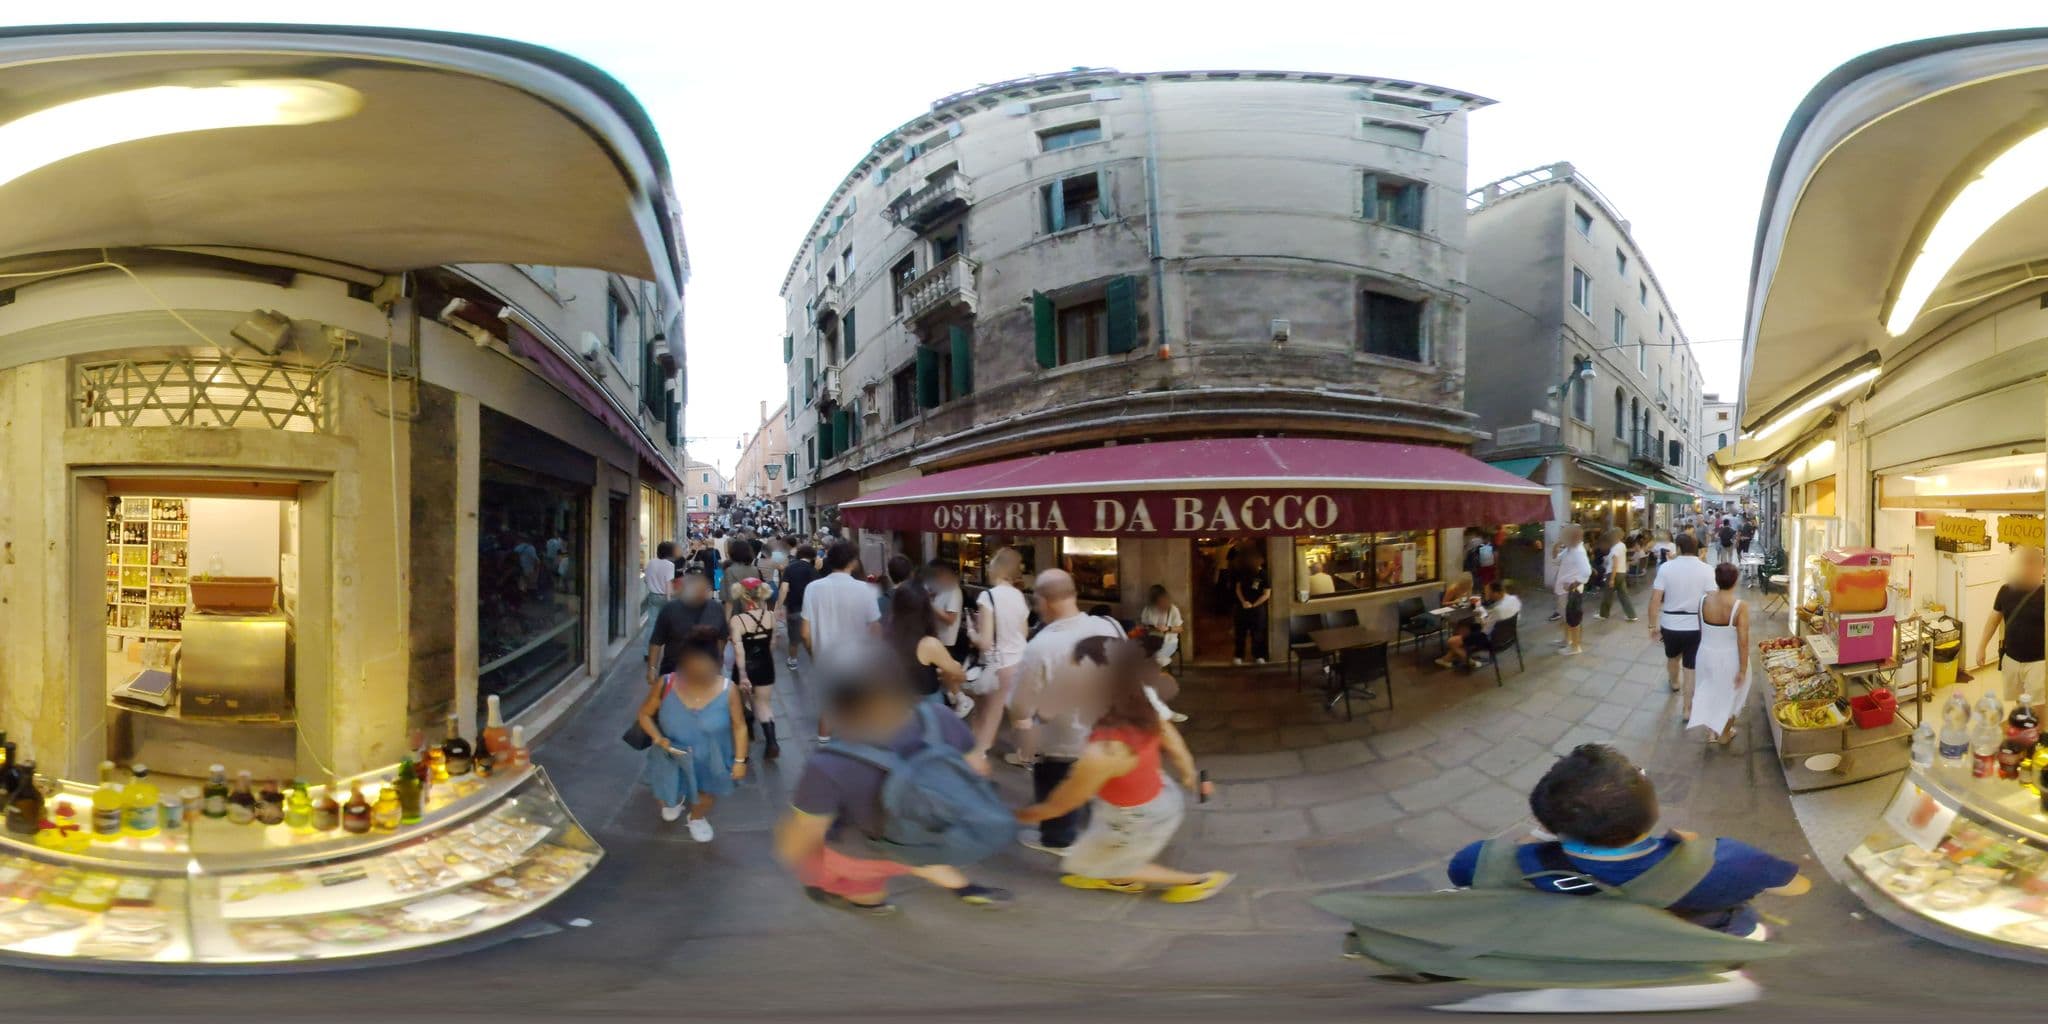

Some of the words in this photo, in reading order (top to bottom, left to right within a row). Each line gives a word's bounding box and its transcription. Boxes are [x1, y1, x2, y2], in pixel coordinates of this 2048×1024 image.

[933, 500, 1068, 531] OSTERIA
[1094, 499, 1157, 532] DA
[1173, 495, 1338, 531] BACCO
[1940, 521, 1978, 537] WINE
[2003, 524, 2045, 539] LIQUO
